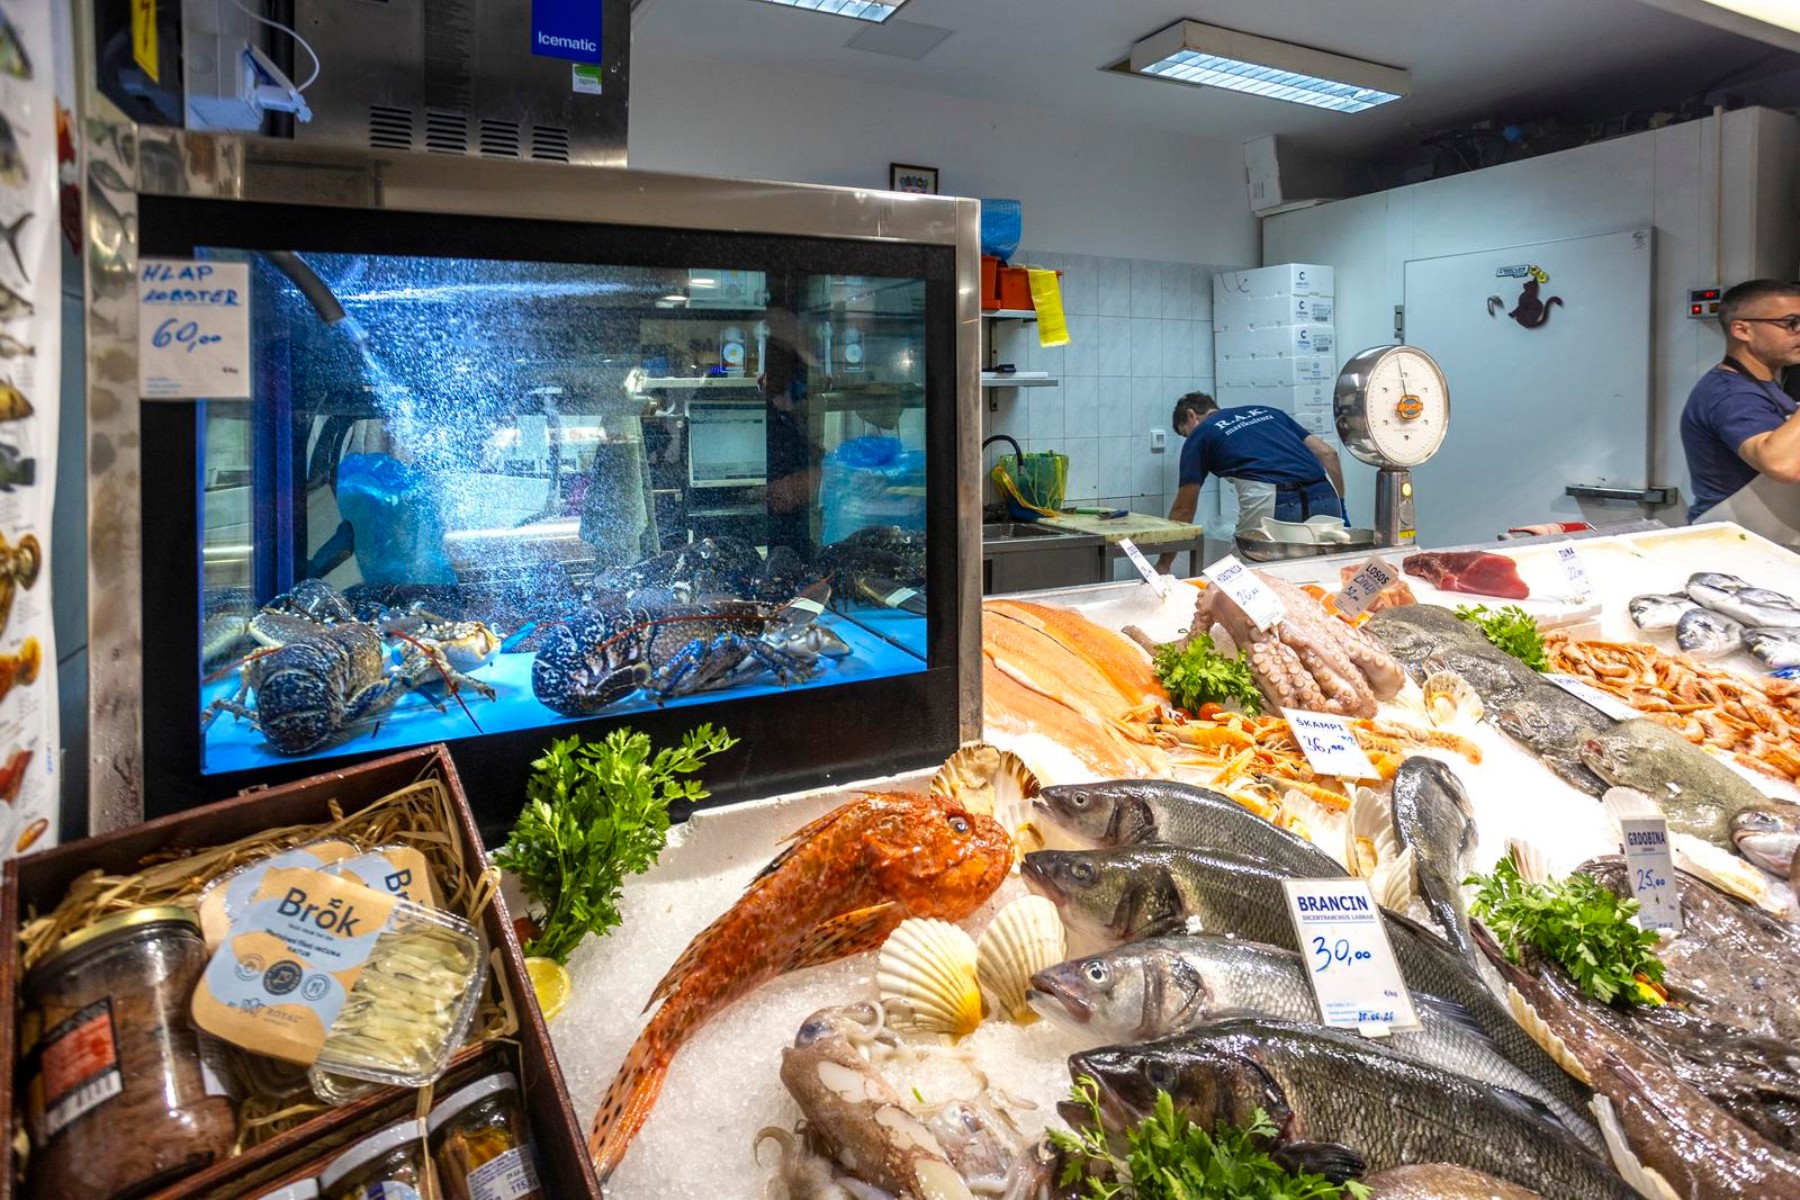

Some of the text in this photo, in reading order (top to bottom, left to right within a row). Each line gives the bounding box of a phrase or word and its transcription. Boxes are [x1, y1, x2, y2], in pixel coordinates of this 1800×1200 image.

[538, 30, 597, 52] Icematic
[142, 264, 213, 282] HLAP
[1214, 408, 1268, 430] R.A.K.
[1365, 563, 1390, 585] LOSOS
[1296, 716, 1344, 731] ŠKAMPI
[1627, 831, 1666, 846] GRDOBINA
[1297, 896, 1369, 912] BRANCIN
[1312, 936, 1371, 973] 30,00
